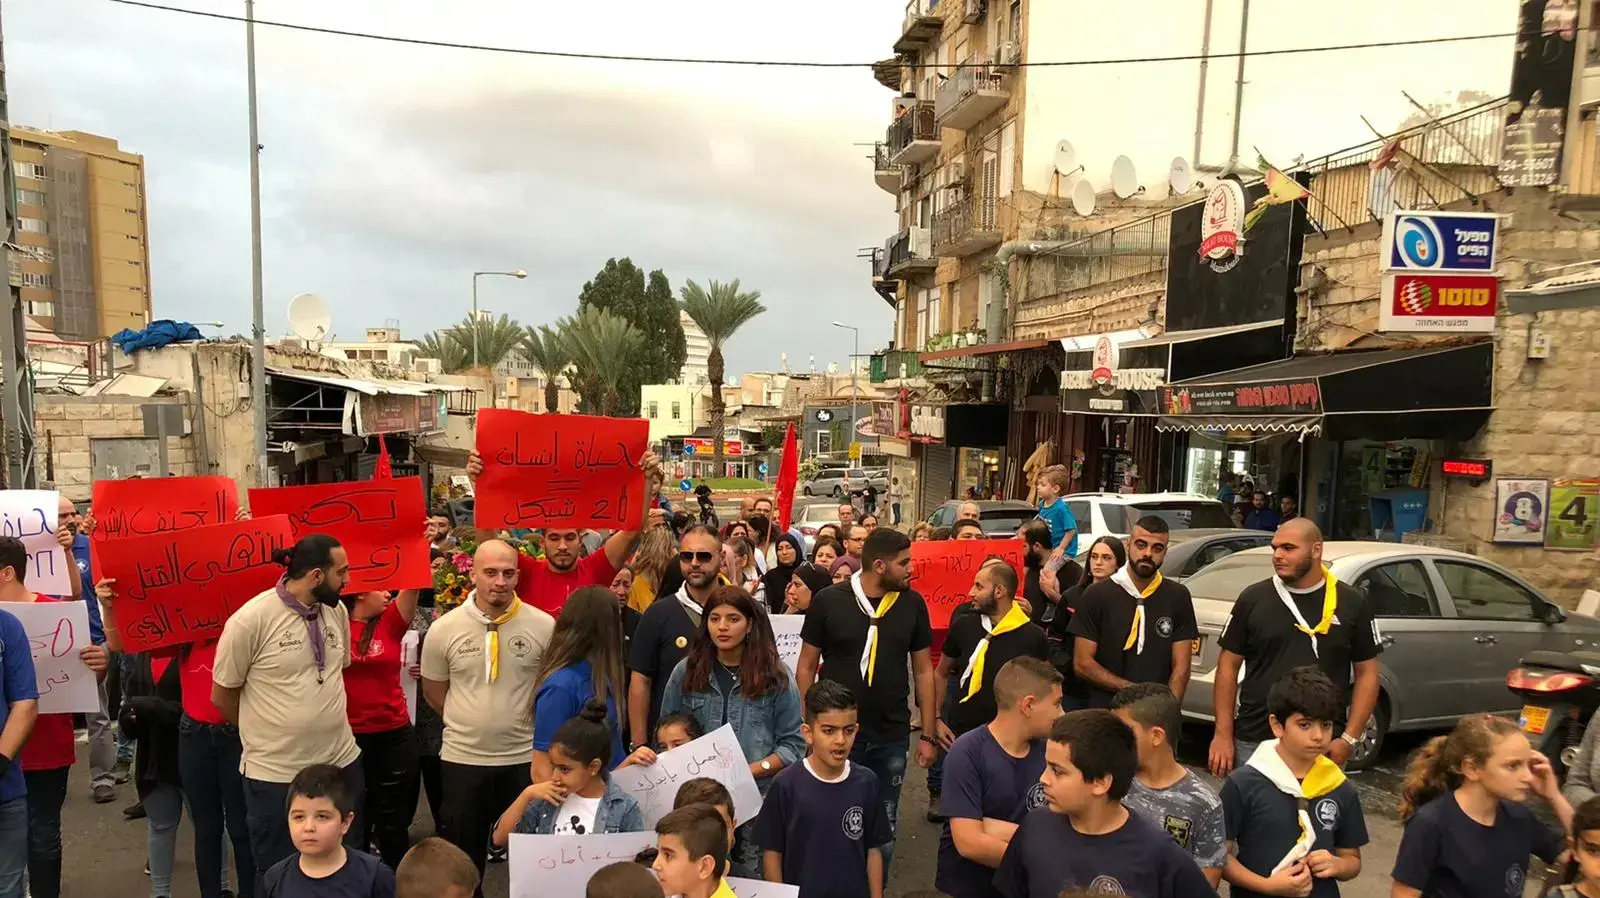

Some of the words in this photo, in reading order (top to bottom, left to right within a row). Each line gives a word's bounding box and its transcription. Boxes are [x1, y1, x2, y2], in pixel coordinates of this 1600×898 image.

[1454, 228, 1490, 243] מפעל
[1457, 244, 1488, 256] הפיס
[1445, 319, 1468, 327] מפגש
[1116, 368, 1165, 390] HOUSE
[496, 430, 560, 474] إنسان
[574, 432, 634, 473] حياة
[503, 496, 576, 526] شيكل
[1514, 497, 1533, 521] 8
[1559, 496, 1588, 527] 4
[127, 542, 182, 601] القتل
[458, 647, 480, 655] Scouts
